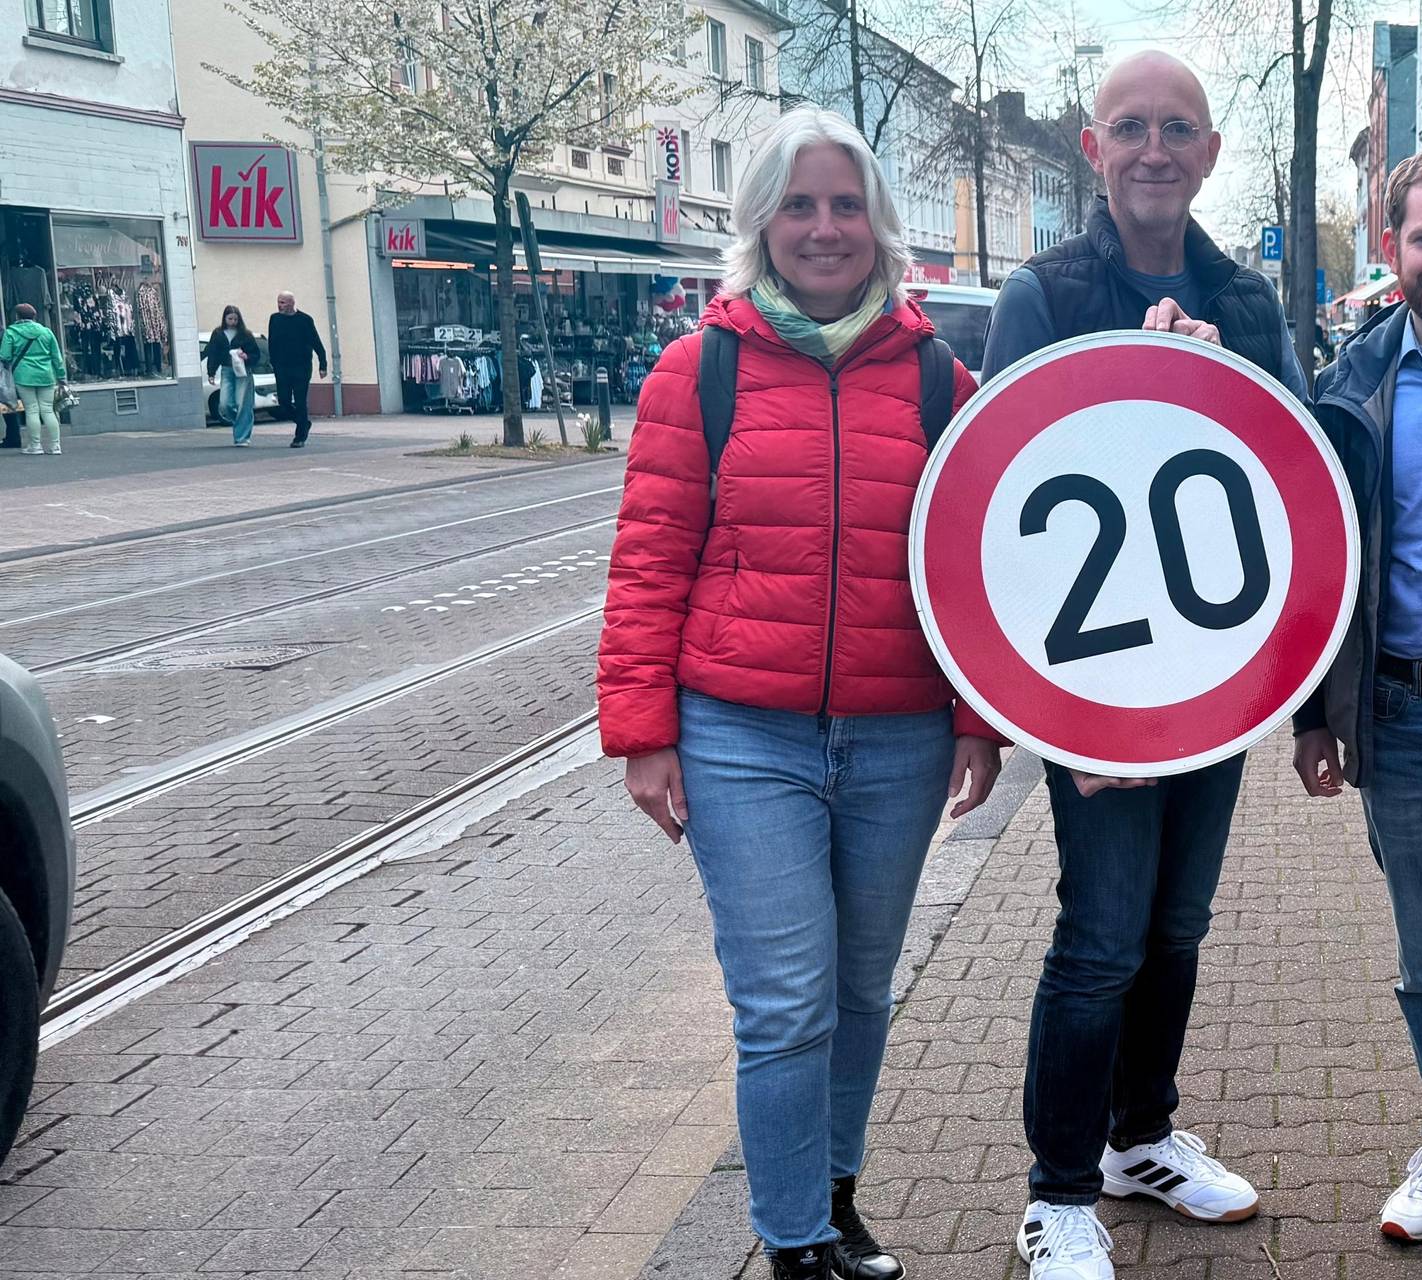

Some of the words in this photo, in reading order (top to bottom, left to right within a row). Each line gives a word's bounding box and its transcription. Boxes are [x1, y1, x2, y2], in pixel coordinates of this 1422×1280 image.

[666, 135, 680, 180] KODI
[209, 154, 284, 228] kik
[387, 224, 416, 250] kik
[1264, 231, 1276, 257] P
[1019, 448, 1271, 666] 20
